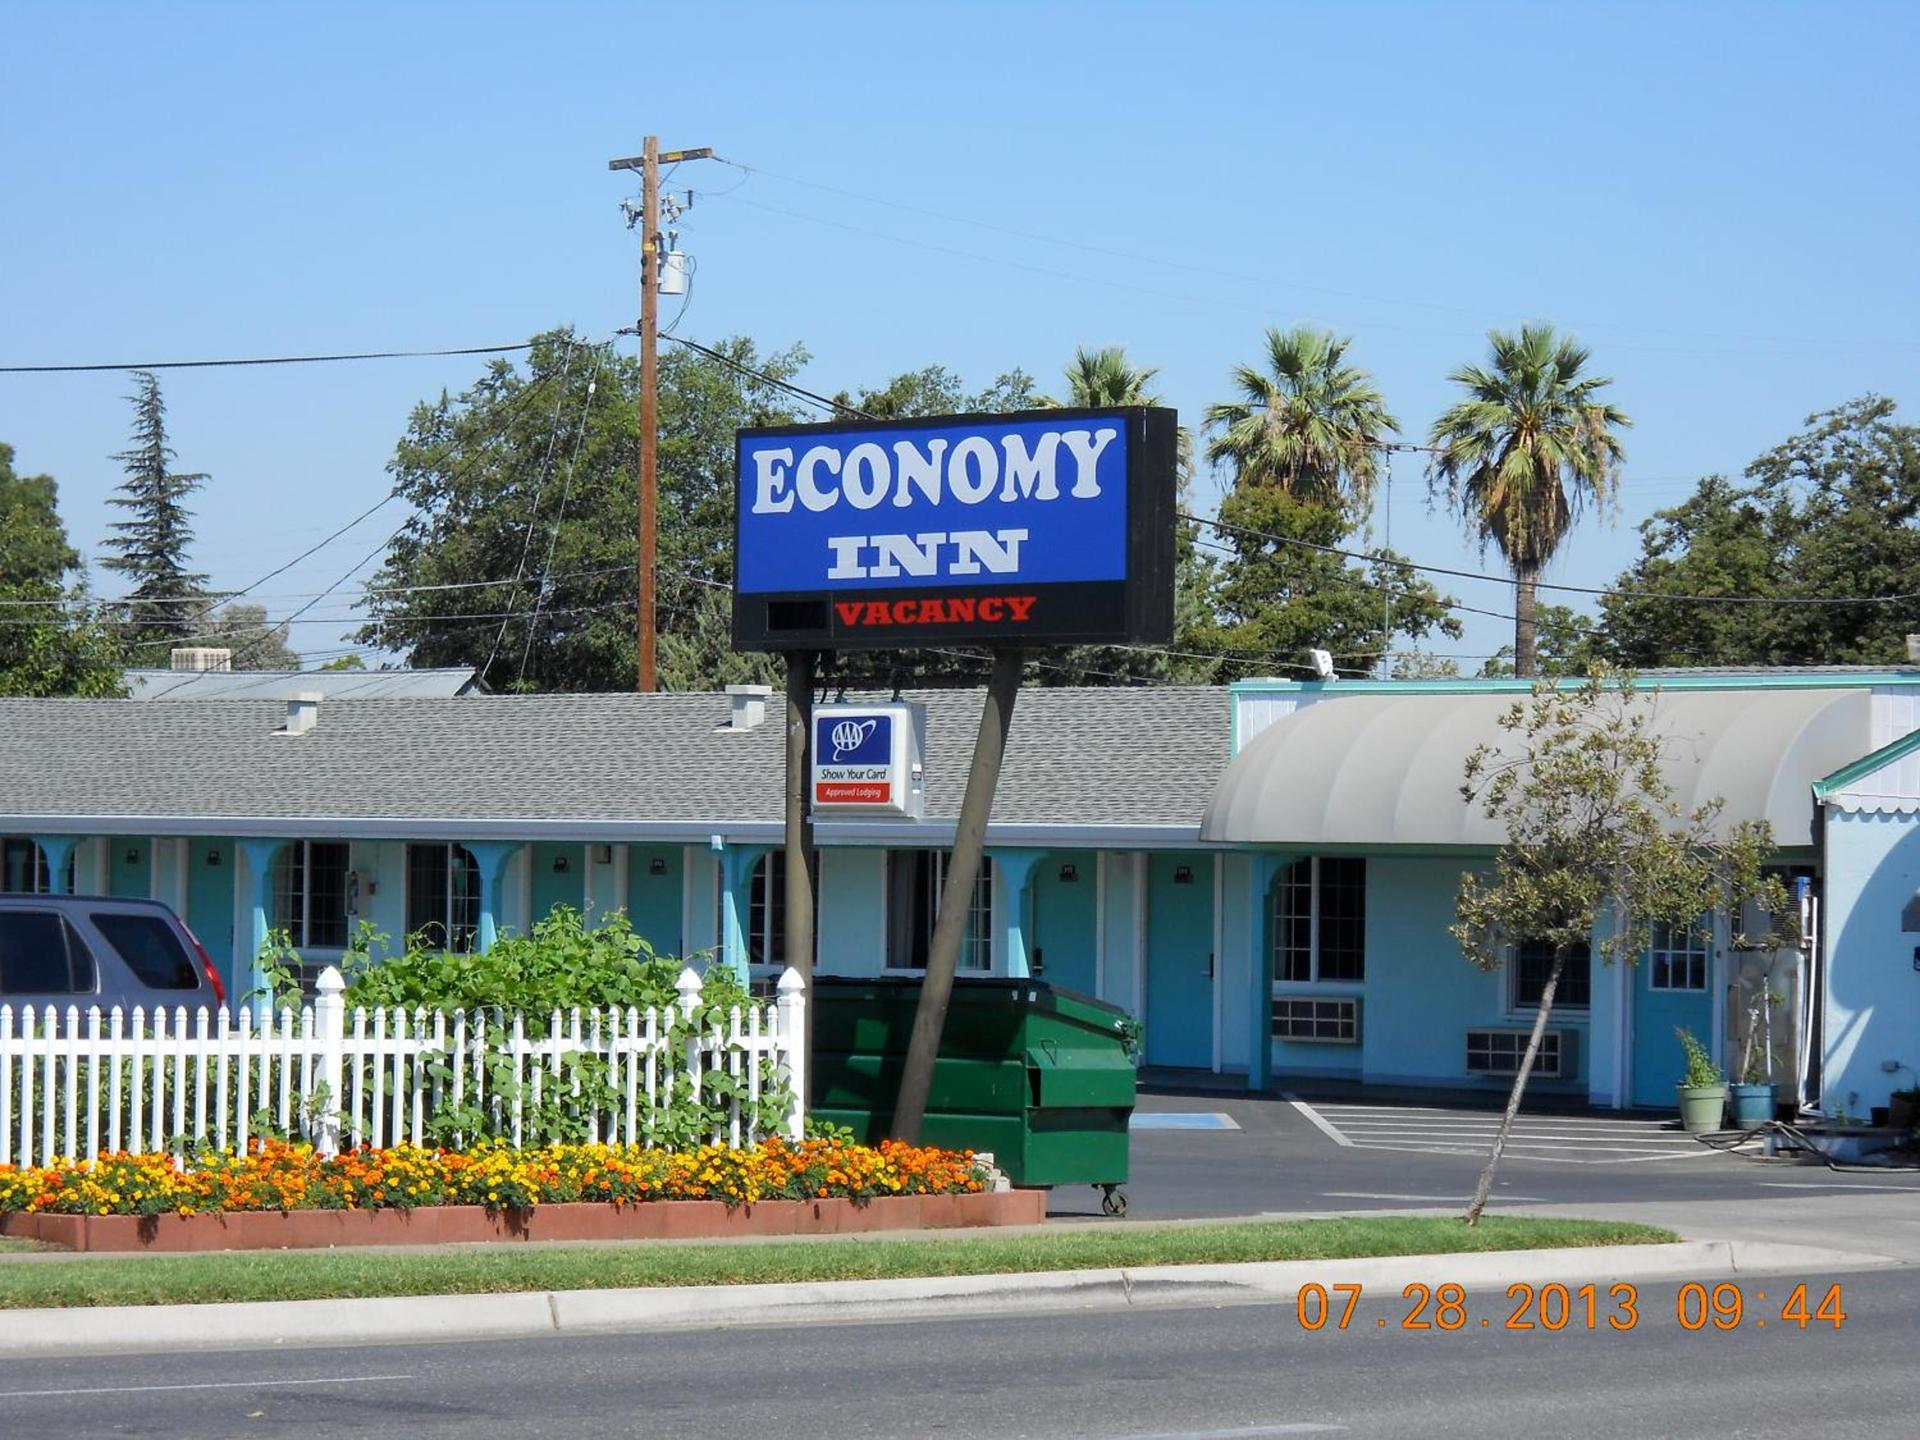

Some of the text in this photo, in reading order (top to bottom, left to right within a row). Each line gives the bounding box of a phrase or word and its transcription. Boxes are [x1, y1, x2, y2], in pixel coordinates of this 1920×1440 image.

[751, 428, 1117, 514] ECONOMY
[827, 528, 1029, 580] INN
[834, 596, 1038, 628] VACANCY
[833, 721, 862, 751] AAA
[821, 768, 887, 780] Show Your Card
[825, 787, 882, 799] Approved Lodging
